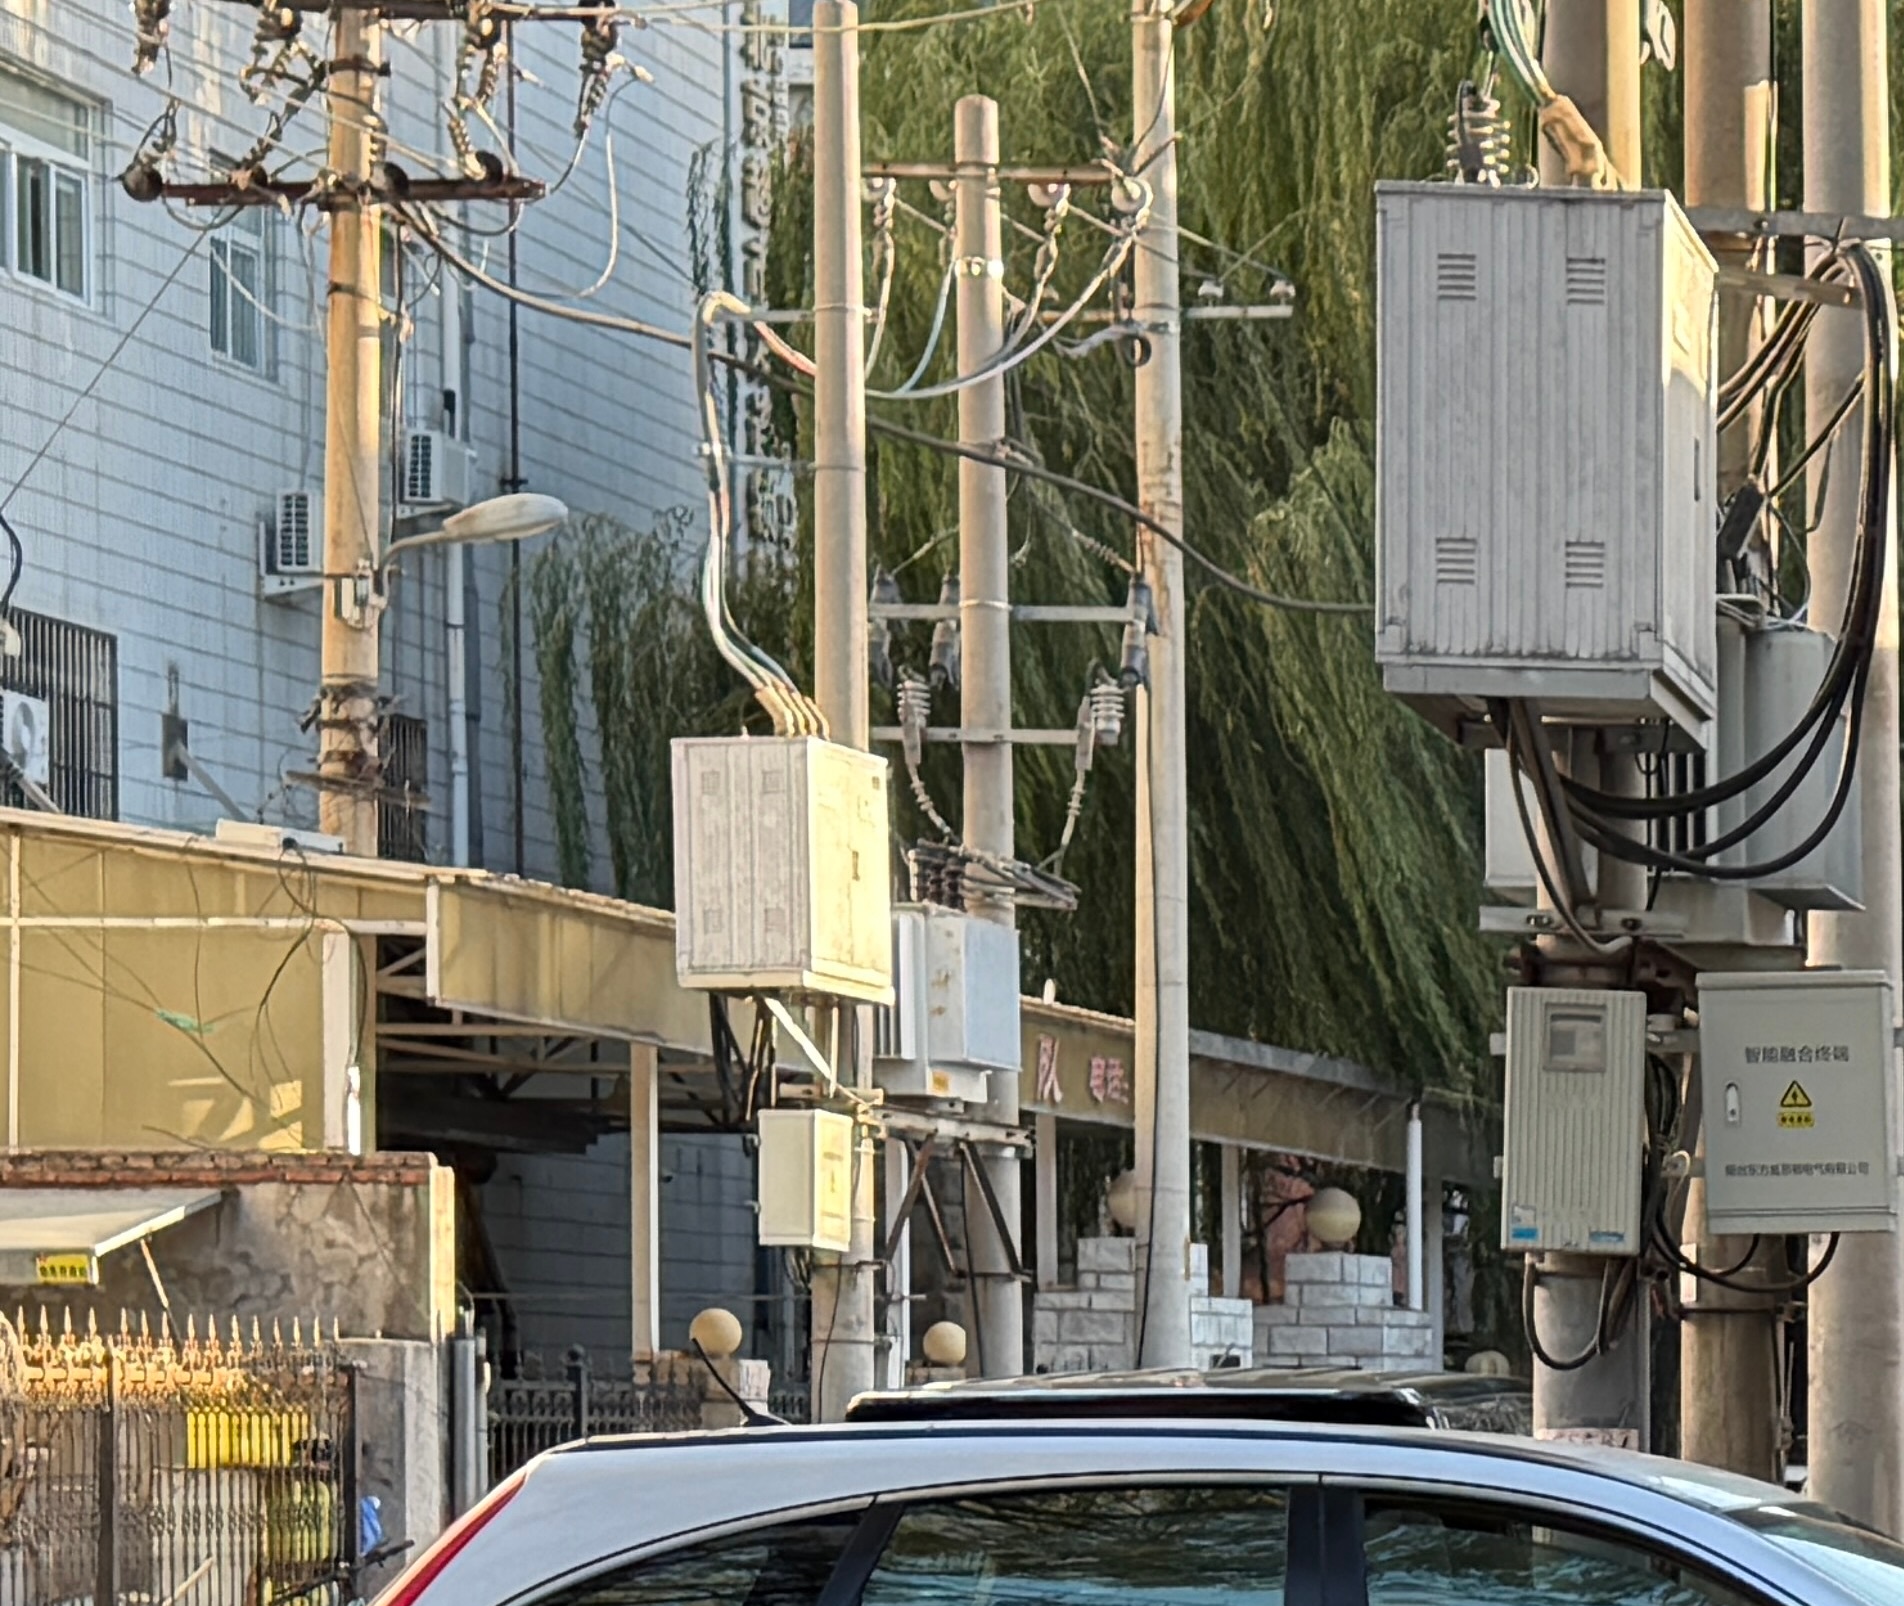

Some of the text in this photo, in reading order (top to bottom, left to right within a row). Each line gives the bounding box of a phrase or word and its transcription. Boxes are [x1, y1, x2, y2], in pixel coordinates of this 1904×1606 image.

[1745, 1045, 1849, 1063] 智能融合终端
